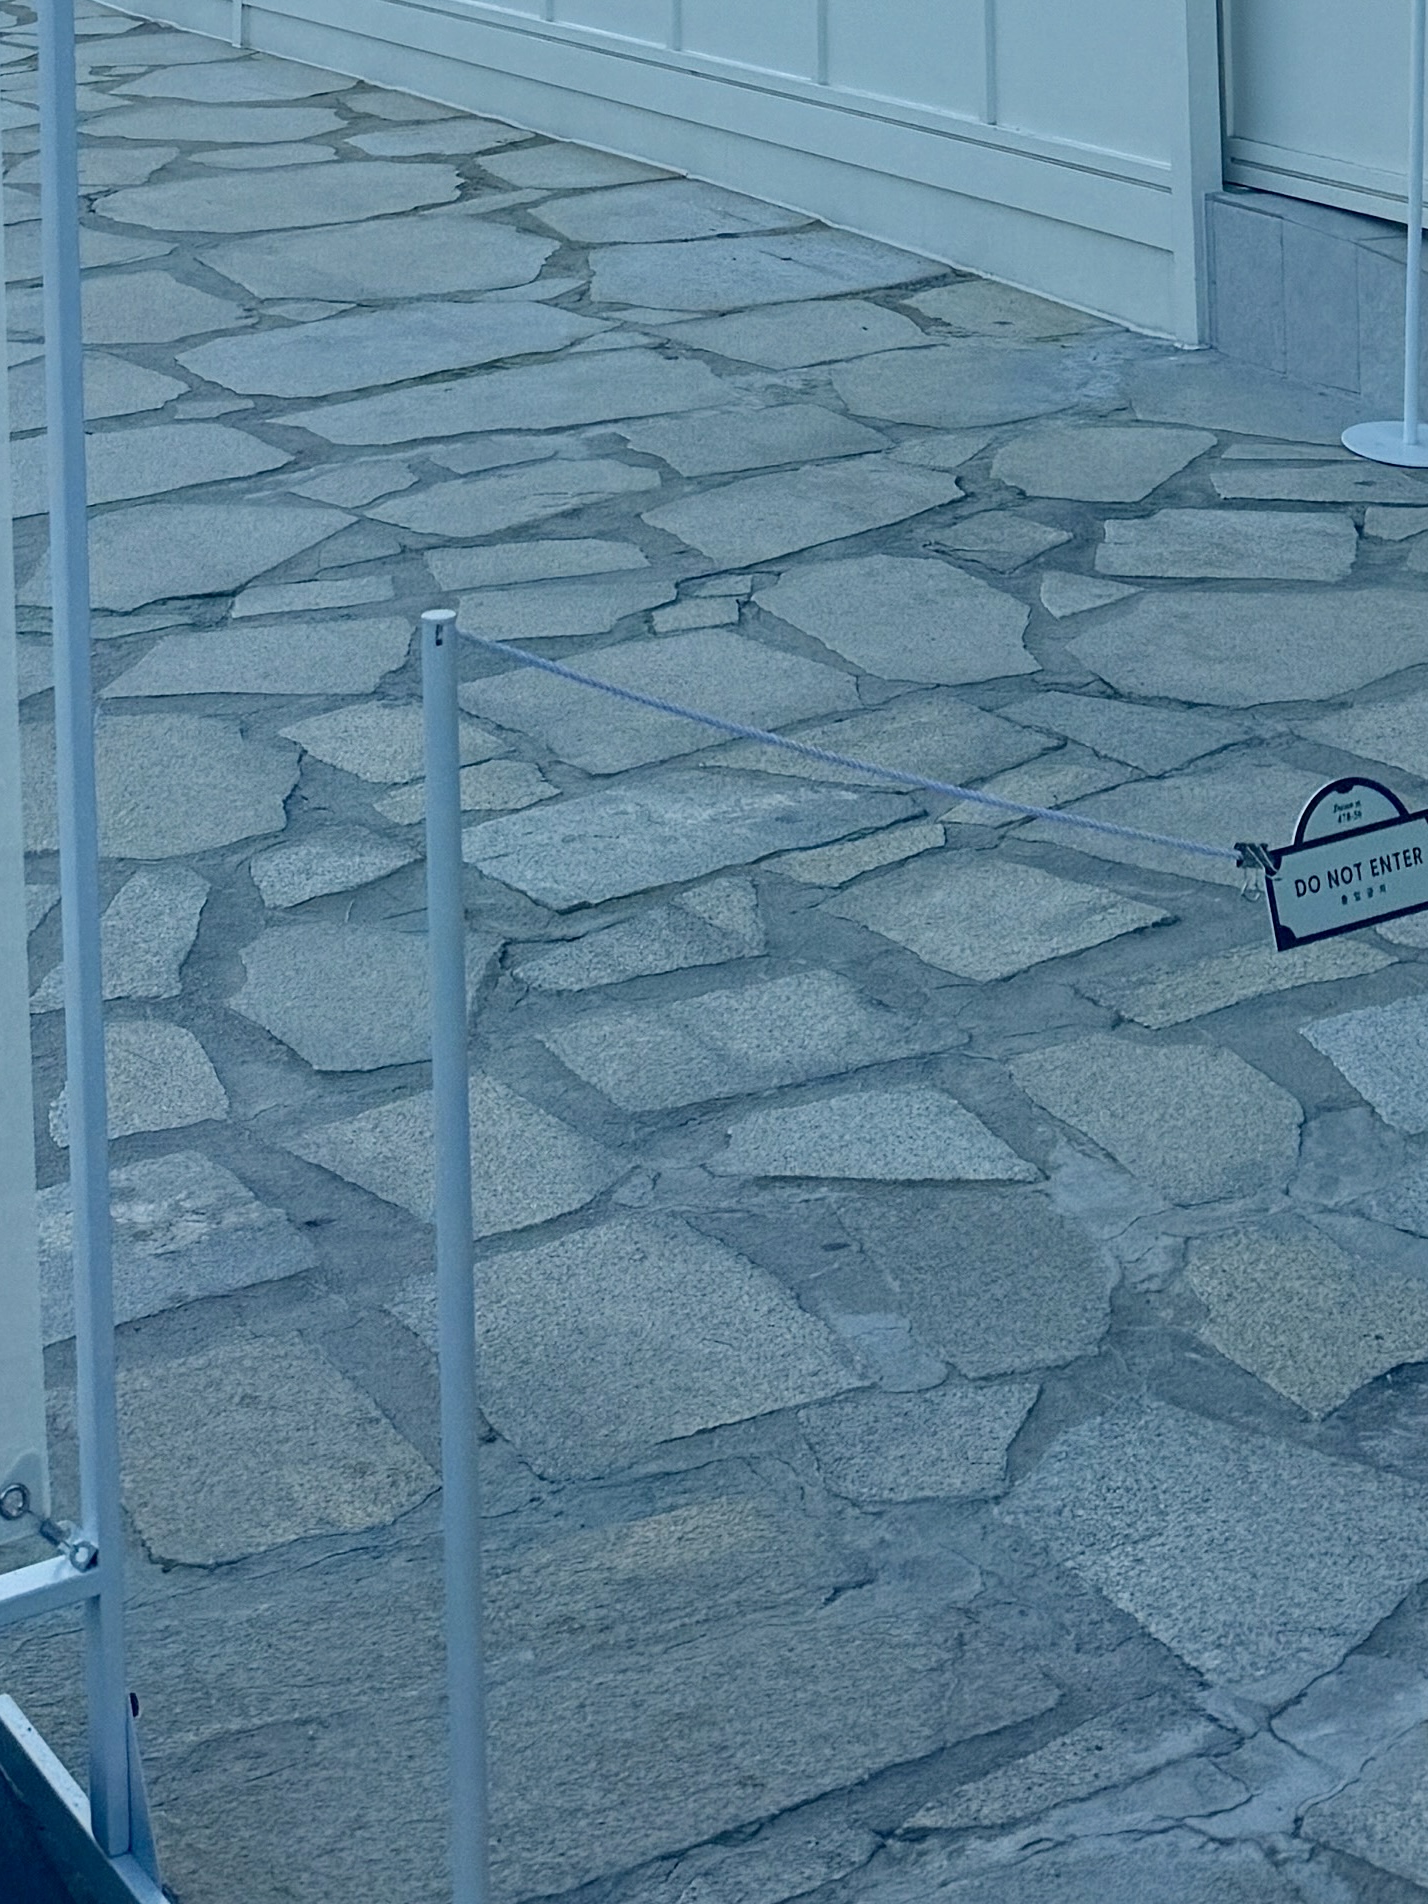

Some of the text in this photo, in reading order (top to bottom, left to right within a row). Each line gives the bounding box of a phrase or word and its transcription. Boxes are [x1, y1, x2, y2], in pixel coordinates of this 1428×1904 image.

[1295, 847, 1423, 897] DO NOT ENTER
